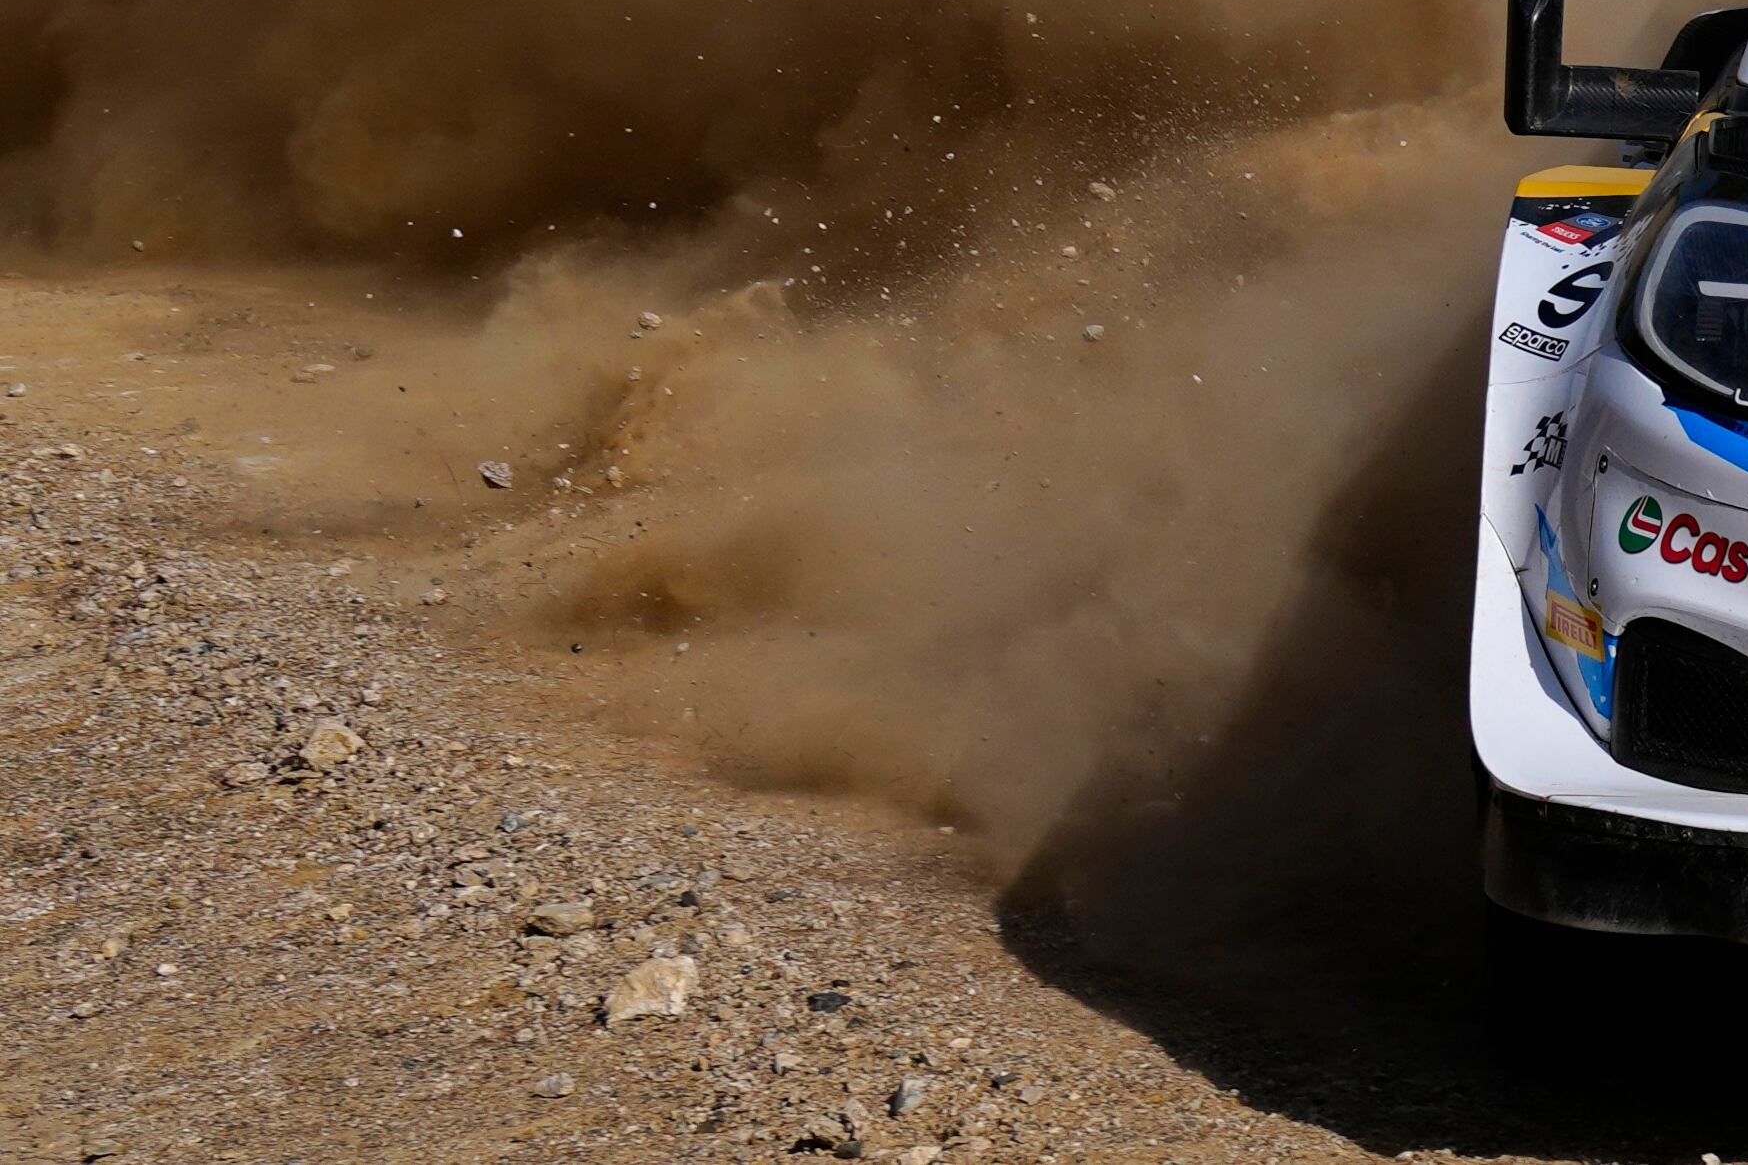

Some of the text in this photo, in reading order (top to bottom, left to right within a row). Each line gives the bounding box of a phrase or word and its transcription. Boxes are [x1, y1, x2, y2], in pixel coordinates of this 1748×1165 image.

[1537, 260, 1615, 329] S
[1505, 325, 1566, 355] sparco
[1550, 600, 1598, 650] PIRELLI
